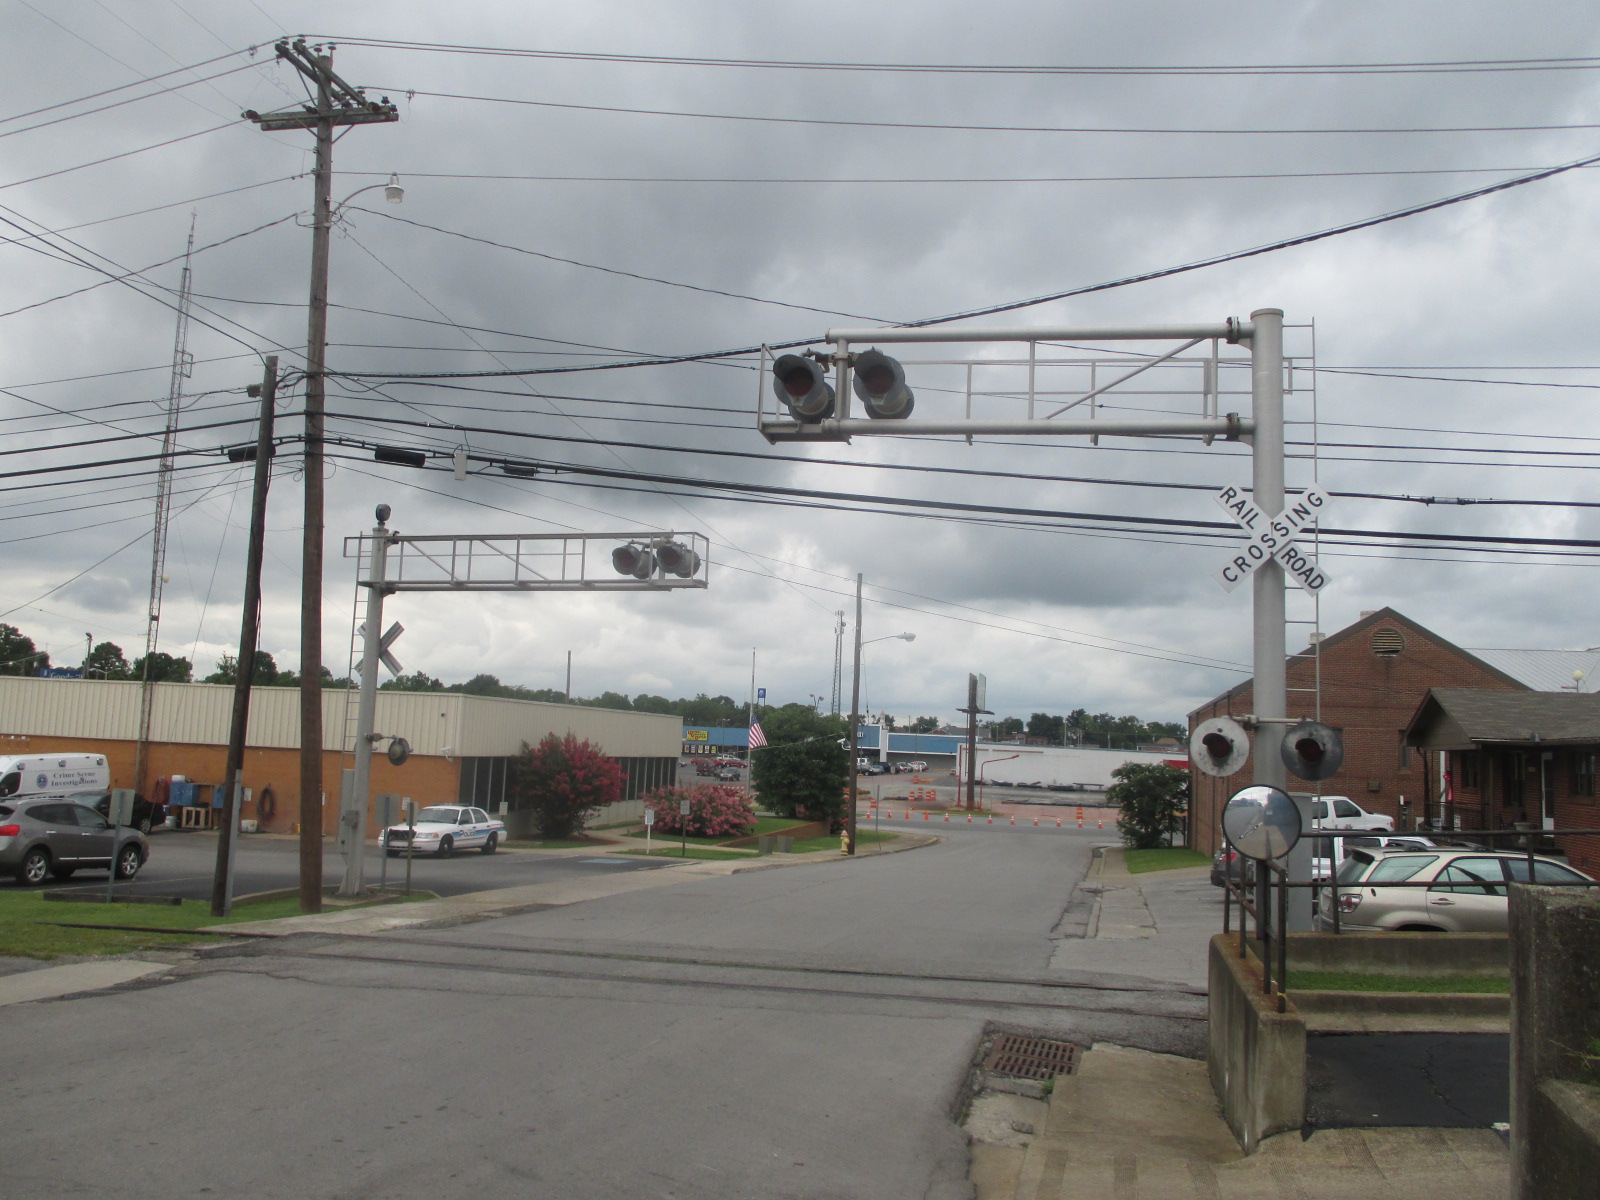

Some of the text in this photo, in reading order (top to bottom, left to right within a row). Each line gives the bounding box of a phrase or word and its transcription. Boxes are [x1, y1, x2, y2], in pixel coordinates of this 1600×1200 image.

[1219, 486, 1325, 590] RAIL ROAD
[1222, 492, 1323, 582] CROSSING
[51, 778, 98, 787] Investigations
